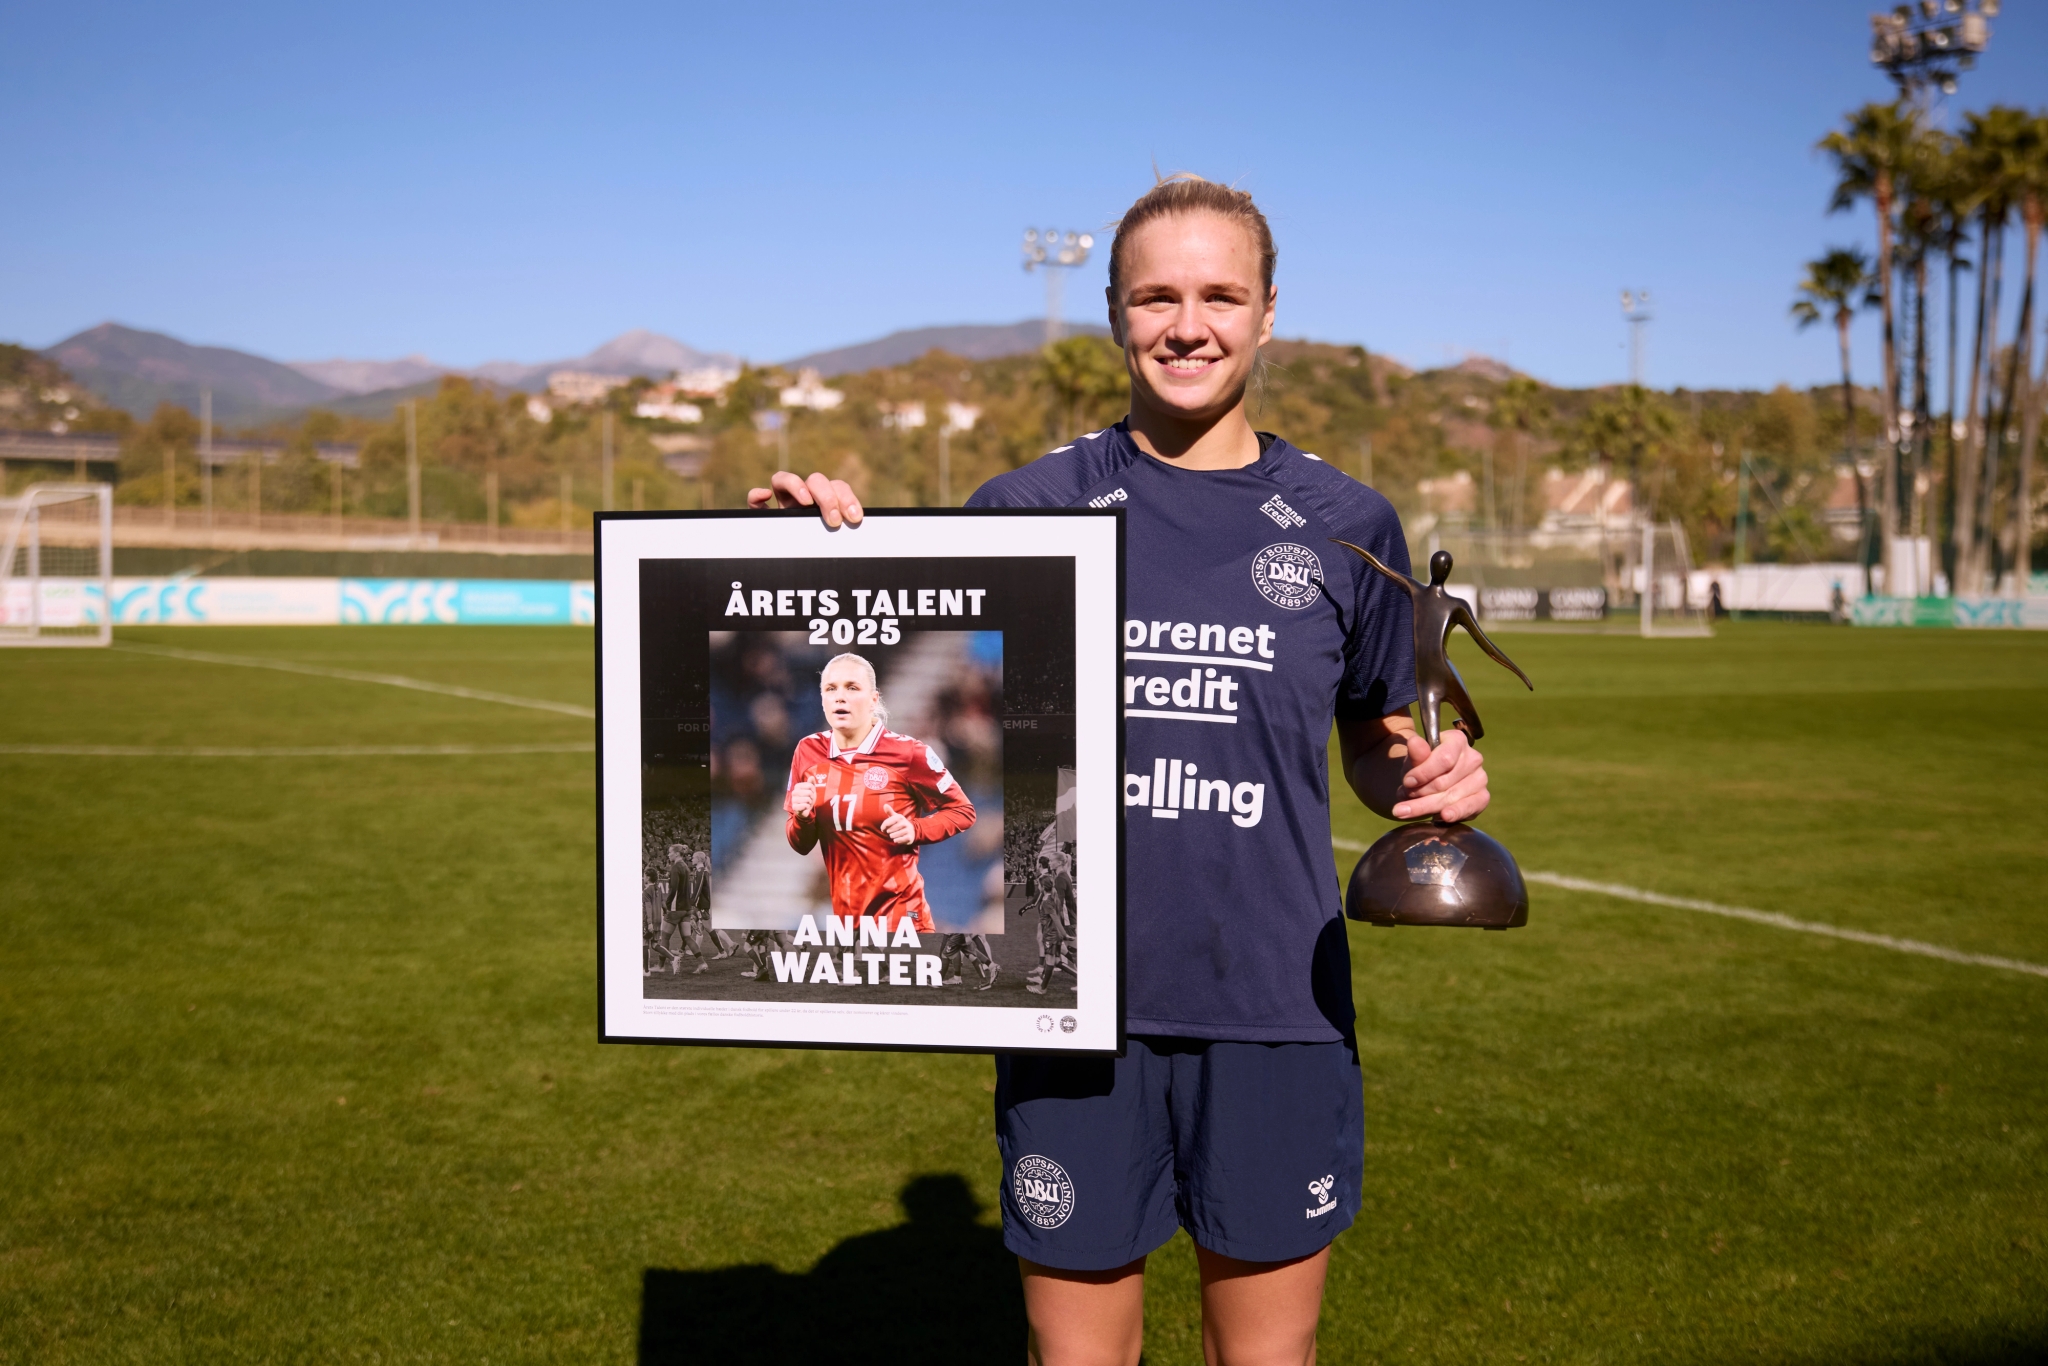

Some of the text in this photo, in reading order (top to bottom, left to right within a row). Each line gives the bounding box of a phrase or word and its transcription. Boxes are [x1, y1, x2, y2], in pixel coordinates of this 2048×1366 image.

[1088, 487, 1128, 508] lling
[1270, 493, 1307, 526] Forenet
[1261, 501, 1292, 528] Kredit
[1255, 545, 1321, 603] DANSK BOLDSPIL UNION
[1267, 562, 1311, 587] DBU
[724, 581, 986, 616] ÅRETS TALENT
[1273, 594, 1301, 607] 1889
[808, 618, 901, 645] 2025
[1124, 619, 1276, 659] orenet
[1124, 667, 1239, 711] redit
[677, 723, 700, 732] FOR
[1002, 720, 1038, 729] ÆMPE
[1124, 757, 1265, 828] alling
[829, 793, 858, 832] 17
[793, 914, 922, 948] ANNA
[770, 951, 943, 987] WALTER
[1015, 1158, 1072, 1220] DANSK BOLDSPIL UNION
[1023, 1178, 1060, 1203] DBU
[1031, 1214, 1056, 1226] 1889
[1306, 1196, 1337, 1220] hummel
